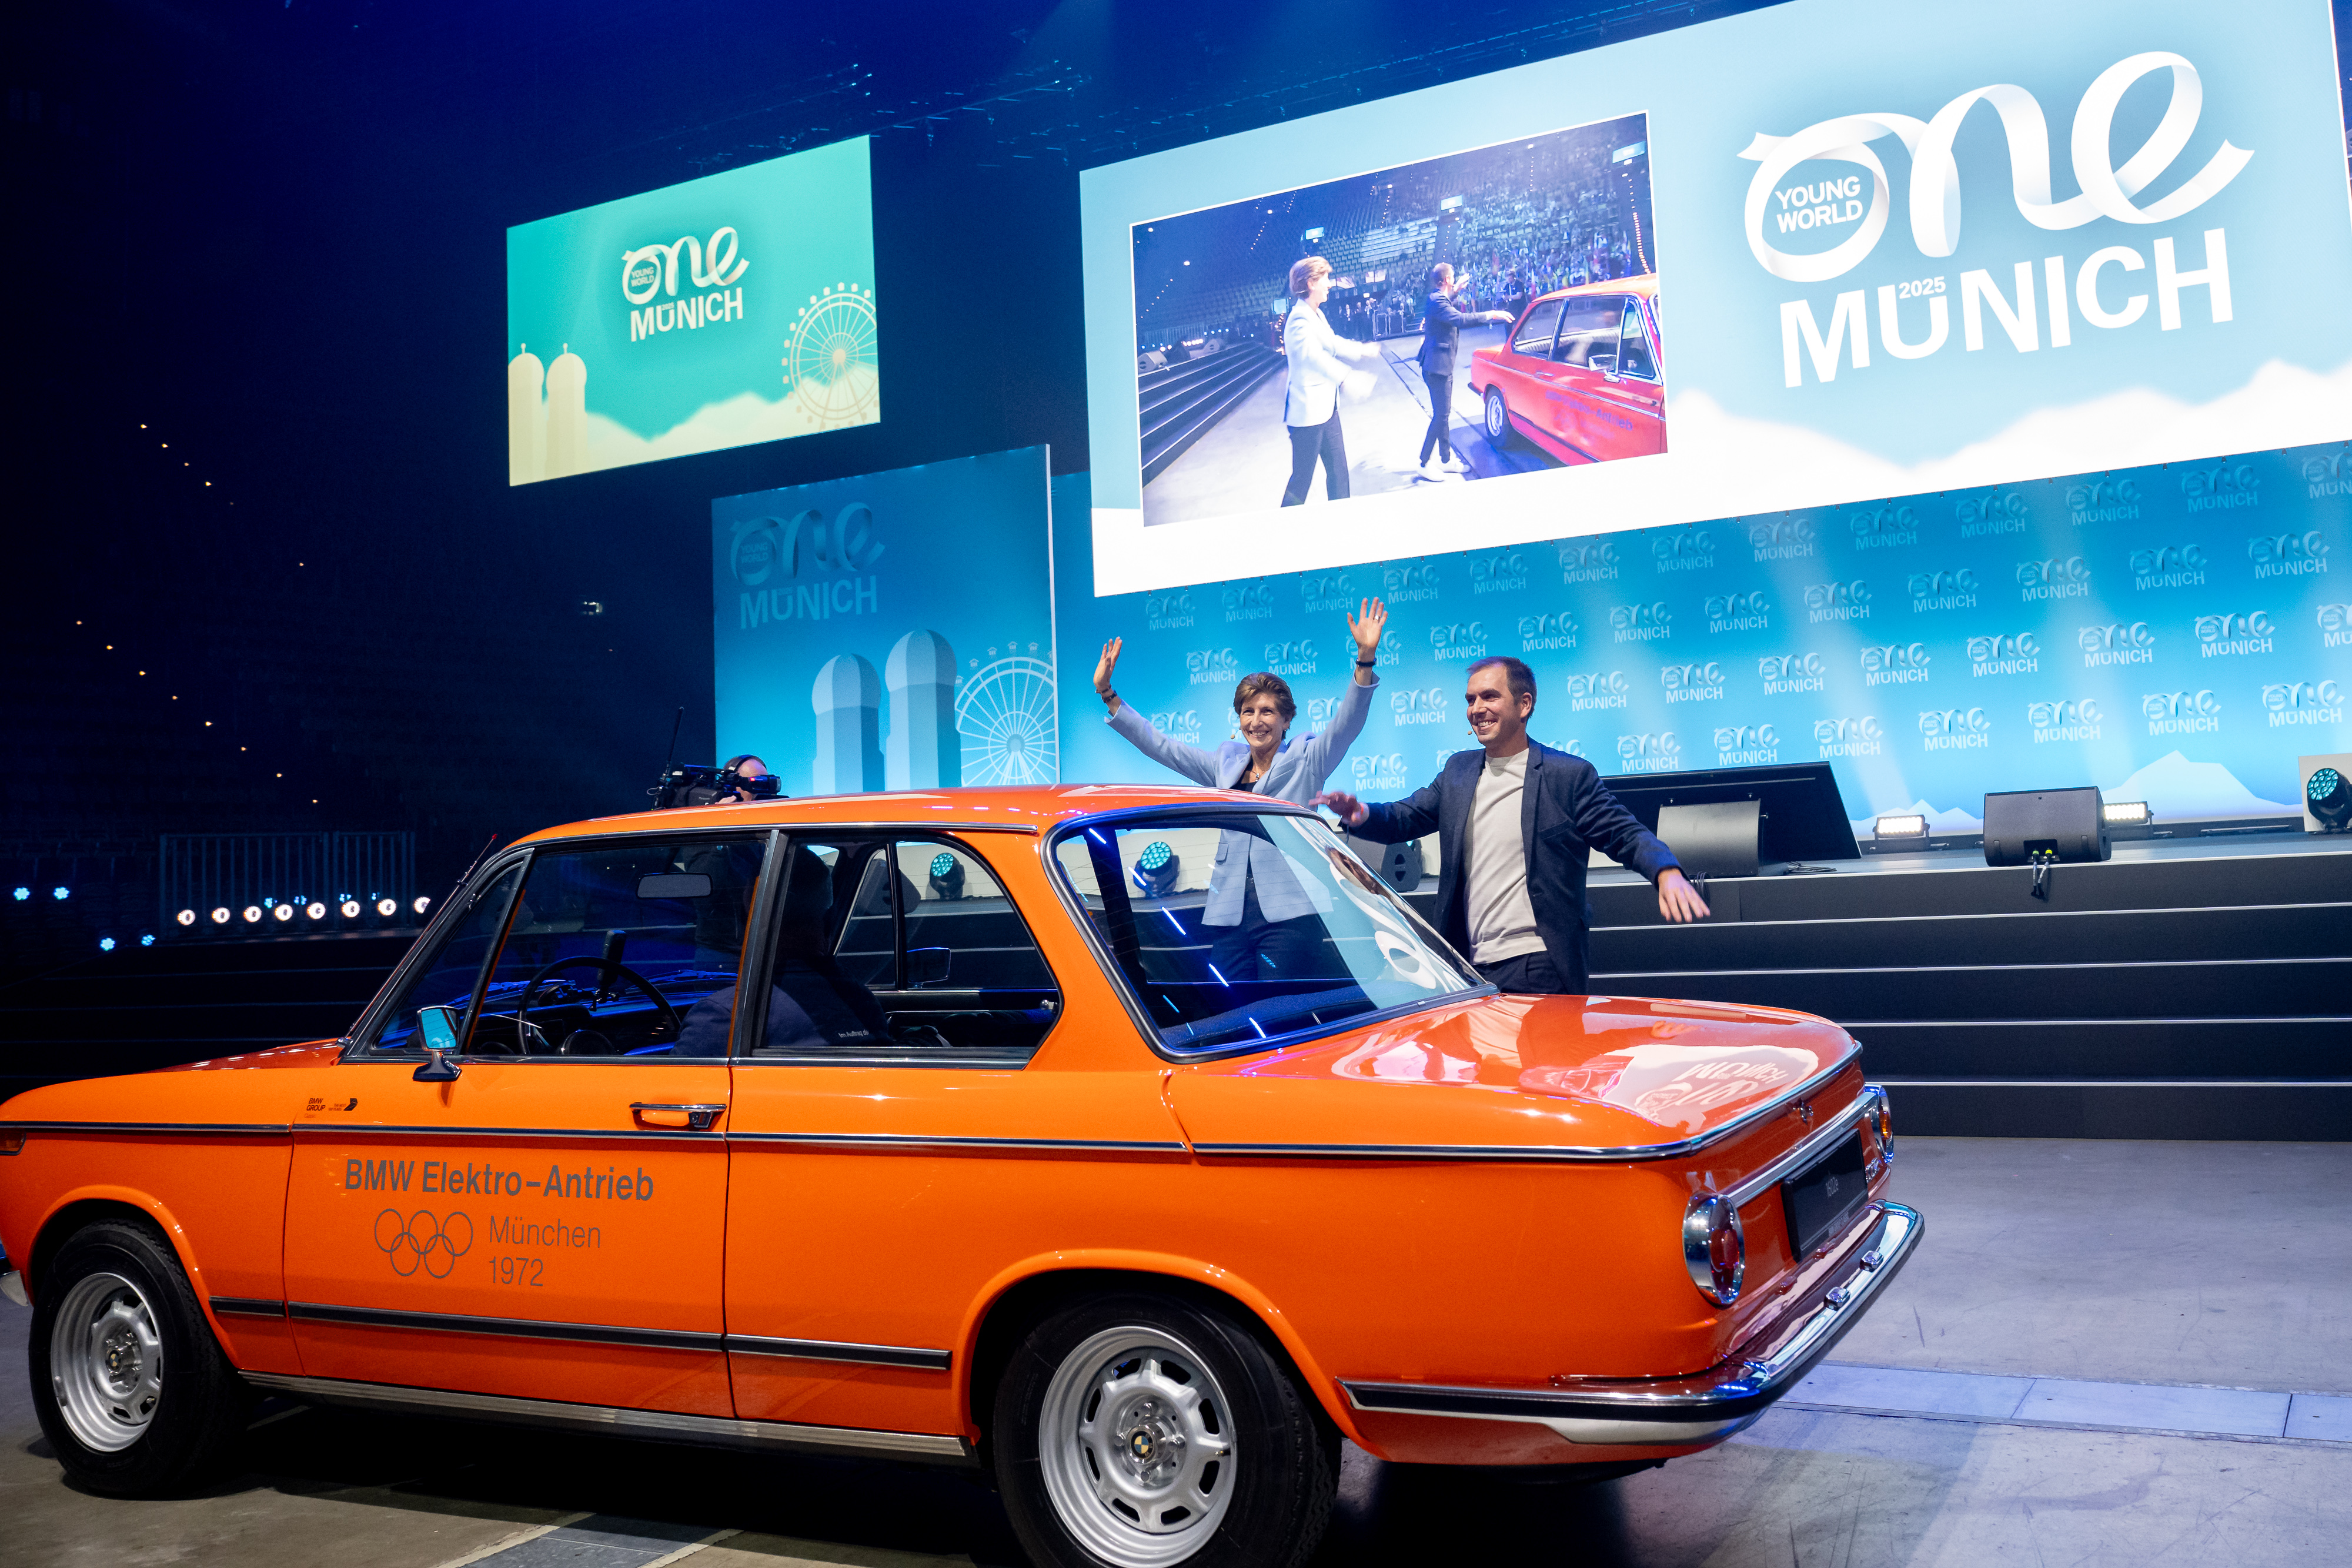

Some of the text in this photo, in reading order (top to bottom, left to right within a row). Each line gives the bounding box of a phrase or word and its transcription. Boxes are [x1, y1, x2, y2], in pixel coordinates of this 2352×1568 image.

[1774, 175, 1861, 211] YOUNG
[1775, 199, 1863, 234] WORLD
[630, 275, 654, 287] WORLD
[631, 266, 654, 278] YOUNG
[1899, 276, 1947, 300] 2025
[741, 542, 768, 554] YOUNG
[741, 553, 769, 564] WORLD
[345, 1158, 653, 1202] BMW Elektro-Antrieb
[489, 1215, 601, 1248] München
[489, 1256, 544, 1287] 1972
